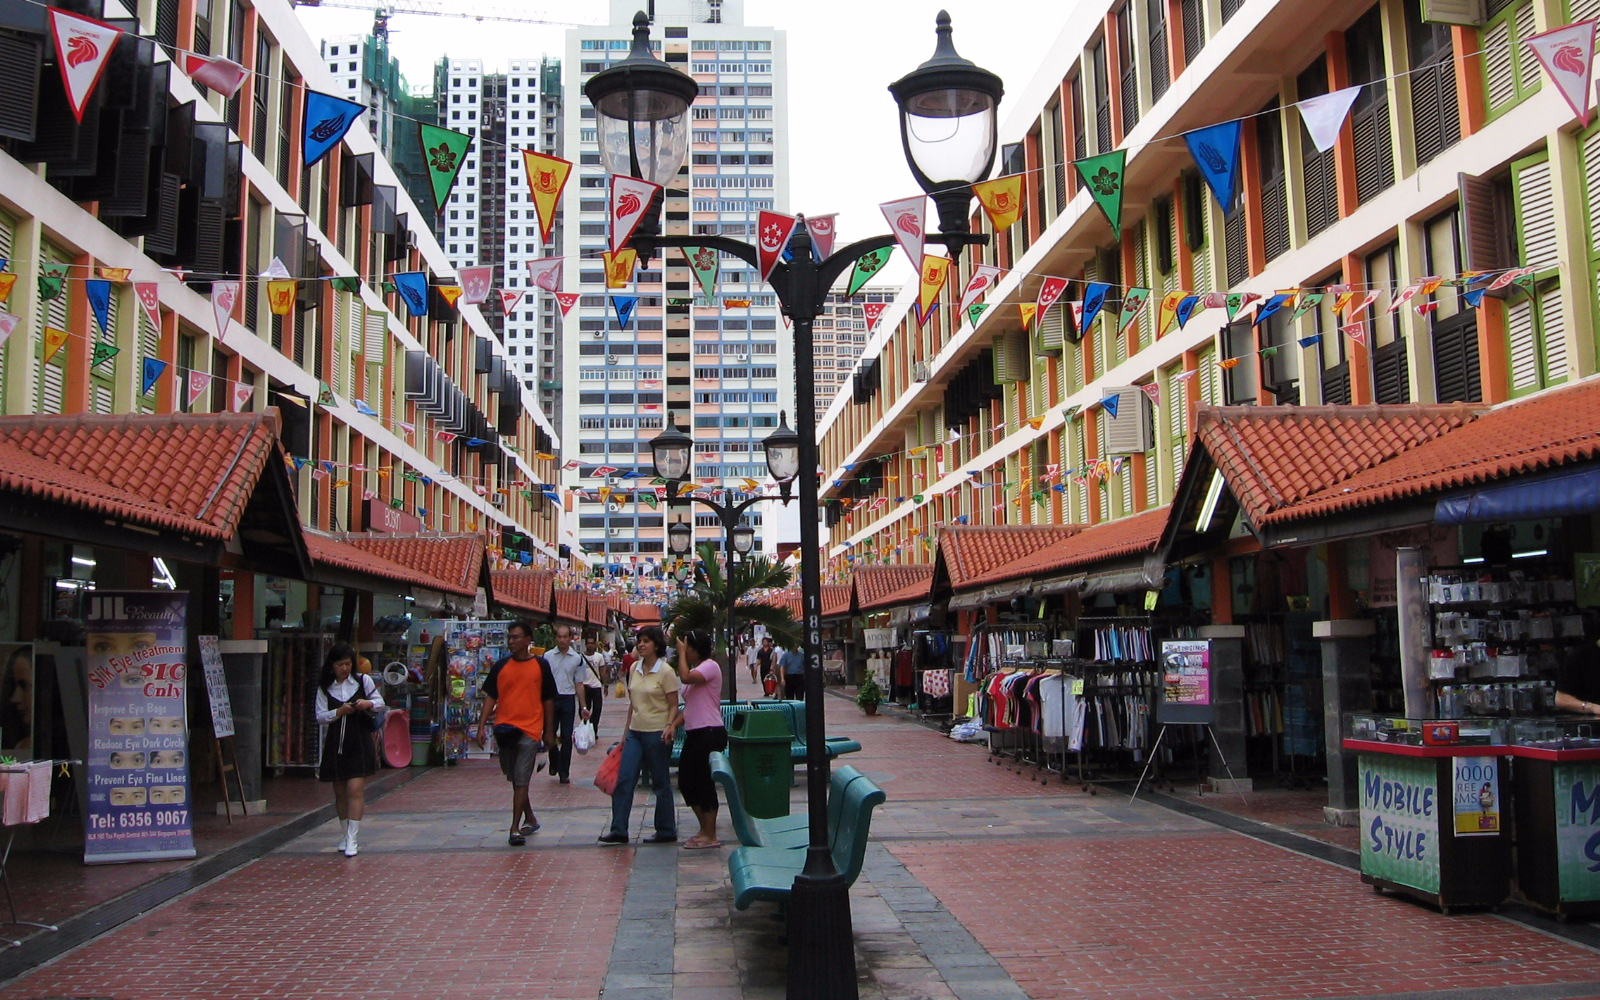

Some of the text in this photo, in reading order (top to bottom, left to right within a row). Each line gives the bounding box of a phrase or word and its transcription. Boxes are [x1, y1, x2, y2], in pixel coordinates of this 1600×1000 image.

[88, 597, 175, 624] JIL Beauty
[109, 657, 133, 673] Eye
[133, 646, 185, 661] treatment
[140, 662, 186, 681] $10
[143, 682, 182, 699] Only
[94, 702, 167, 716] Improve Eye Bags
[94, 738, 185, 751] Reduce Eye Dark Circle
[94, 772, 187, 786] Prevent Eye Fine Lines
[1457, 783, 1476, 792] REE
[1365, 770, 1434, 816] MOBILE
[90, 810, 188, 828] Tel: 6356 9067
[1371, 815, 1426, 860] STYLE
